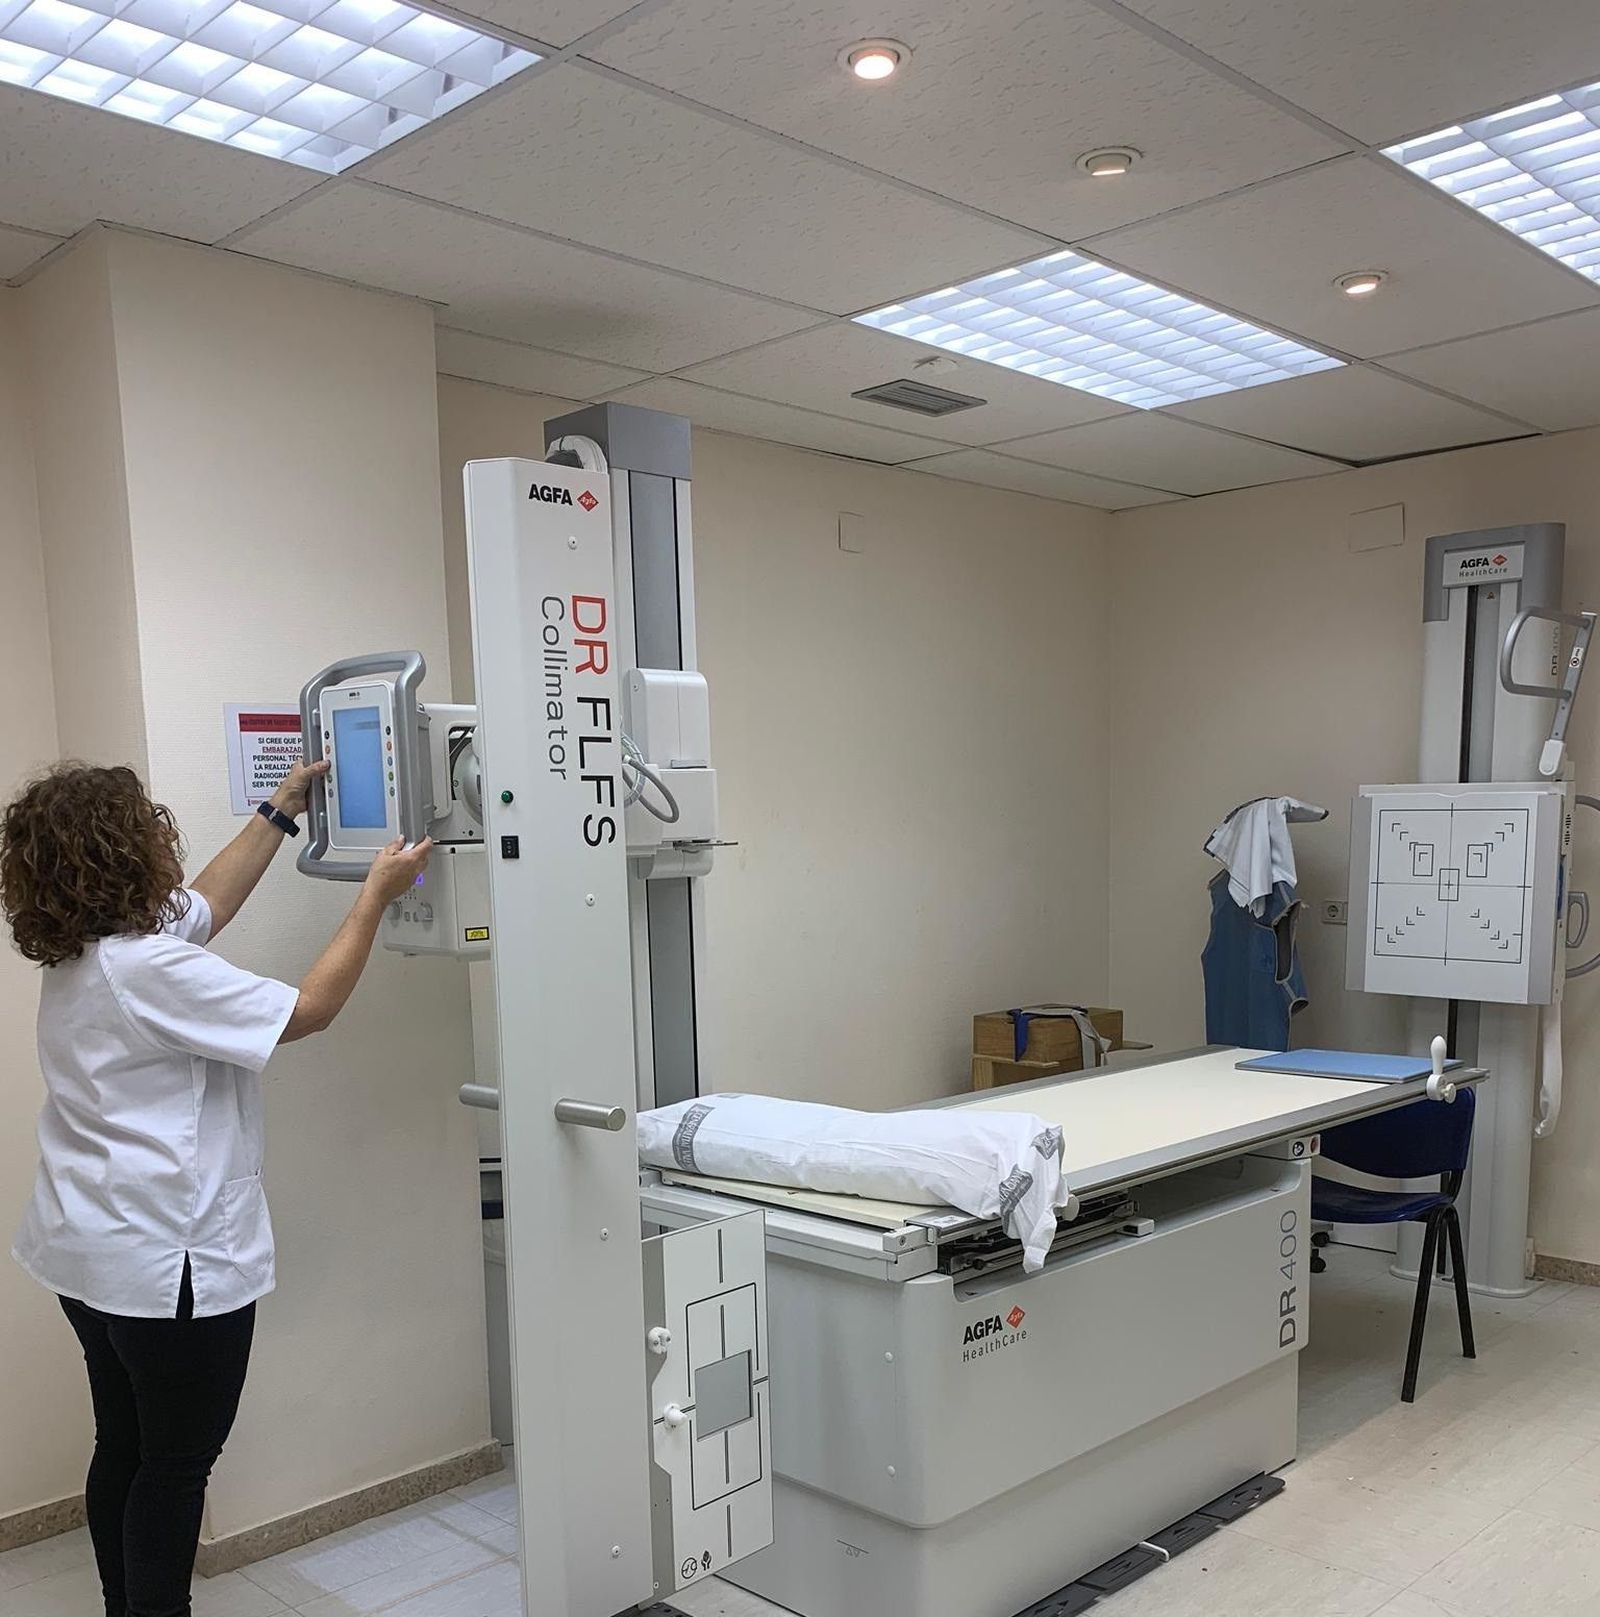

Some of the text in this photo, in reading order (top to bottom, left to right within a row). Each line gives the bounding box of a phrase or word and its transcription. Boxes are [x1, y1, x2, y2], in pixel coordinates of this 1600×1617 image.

[528, 484, 573, 506] AGFA
[1459, 568, 1508, 577] HealthCare
[1460, 557, 1490, 569] AGFA
[541, 595, 568, 780] Collimator
[572, 595, 616, 847] DR FLFS
[254, 771, 290, 779] RADIOGRÁ
[1280, 1210, 1297, 1348] DR 400
[963, 1315, 1003, 1345] AGFA
[963, 1330, 1027, 1362] HealthCare
